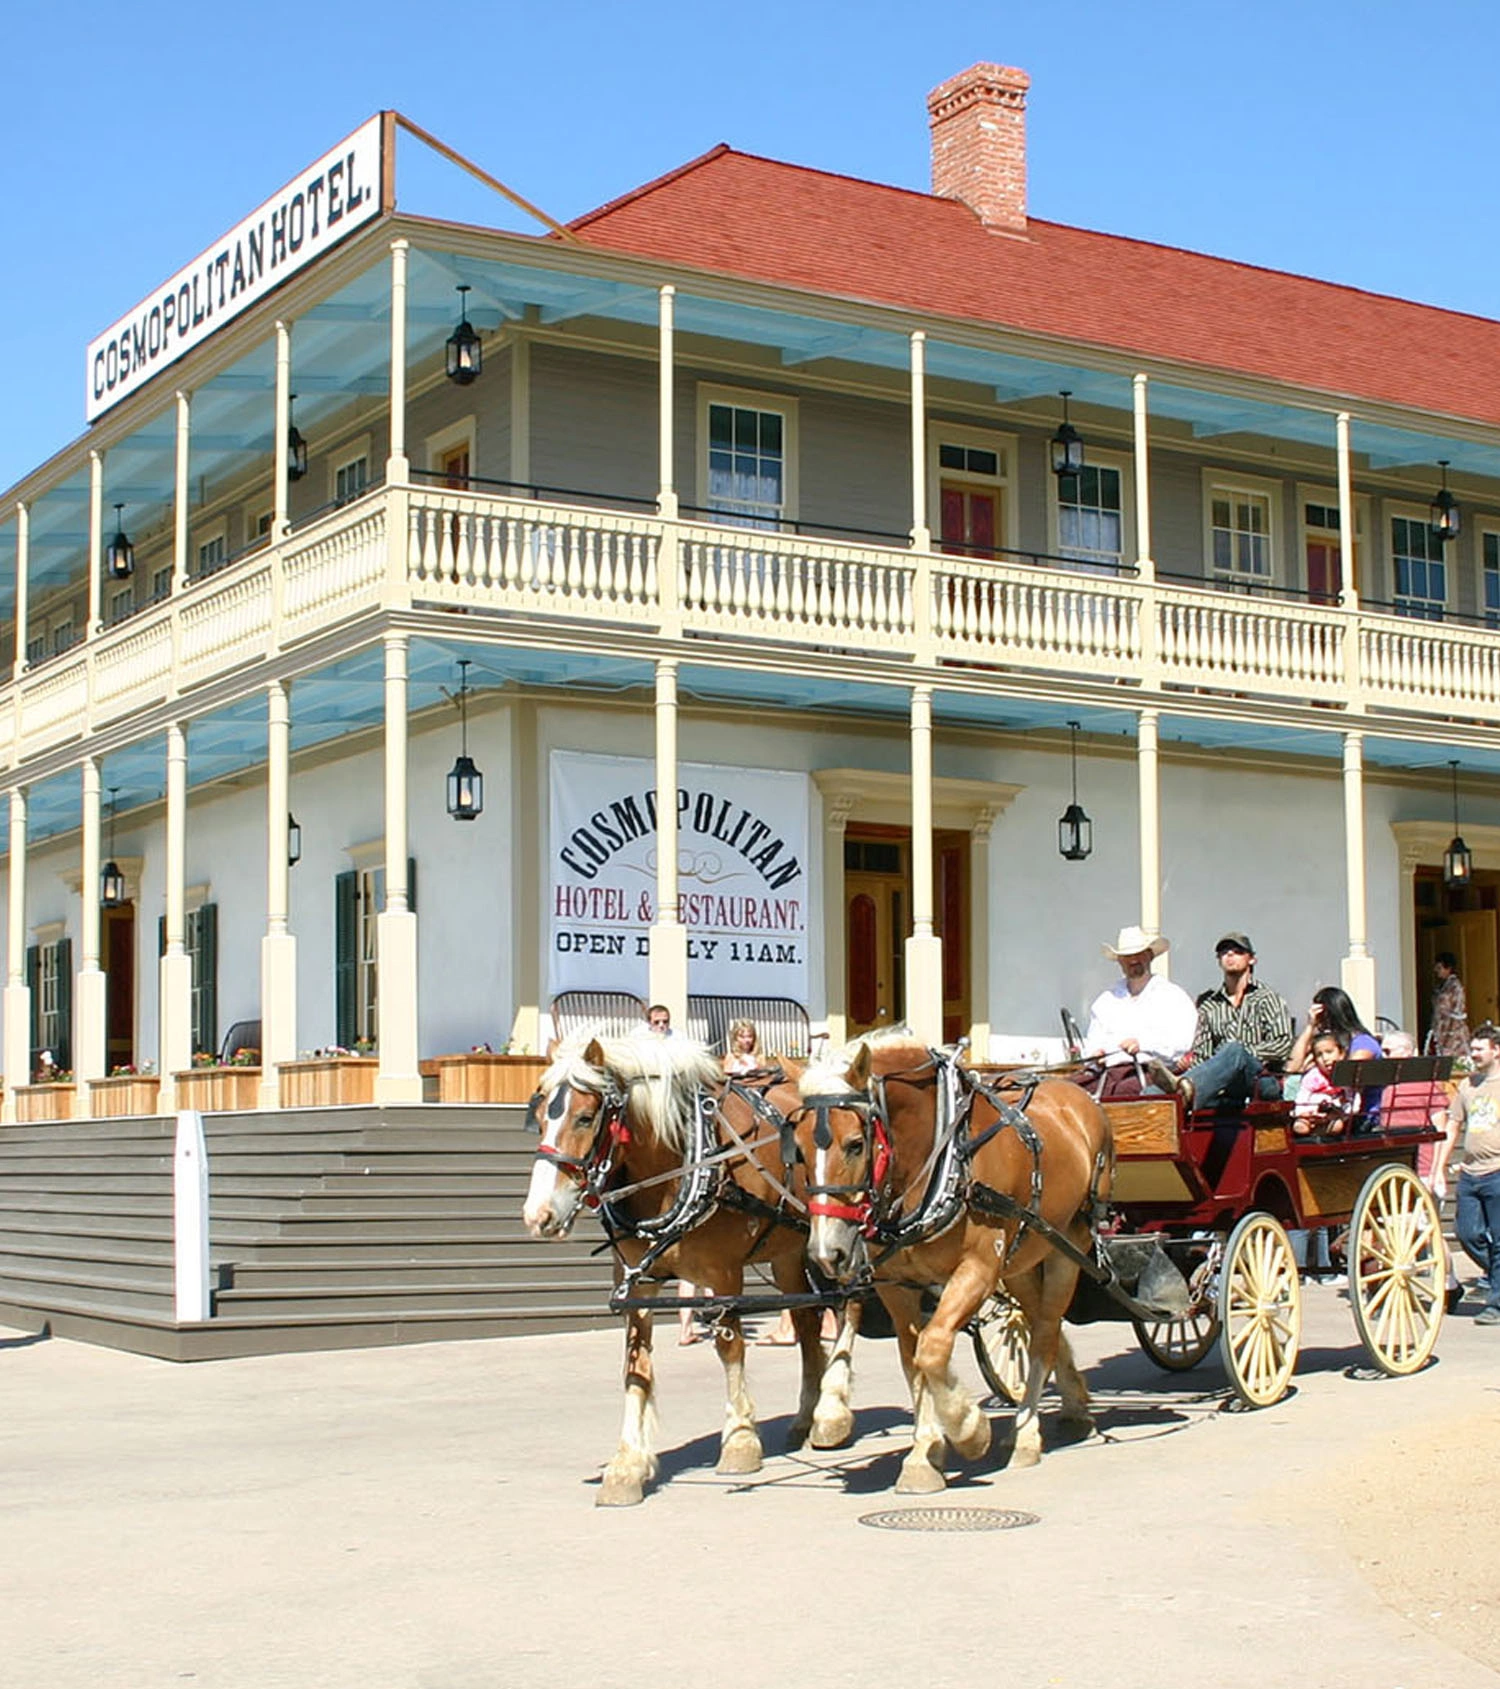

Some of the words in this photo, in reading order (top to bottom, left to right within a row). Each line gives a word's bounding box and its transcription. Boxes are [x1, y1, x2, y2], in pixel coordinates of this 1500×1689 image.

[94, 221, 265, 401] COSMOPOLITAN
[270, 150, 372, 269] HOTEL.
[555, 885, 630, 921] HOTEL
[637, 889, 655, 922] &
[676, 893, 804, 931] ESTAURANT.
[556, 931, 626, 955] OPEN
[635, 936, 719, 960] DLY
[730, 941, 802, 964] 11AM.
